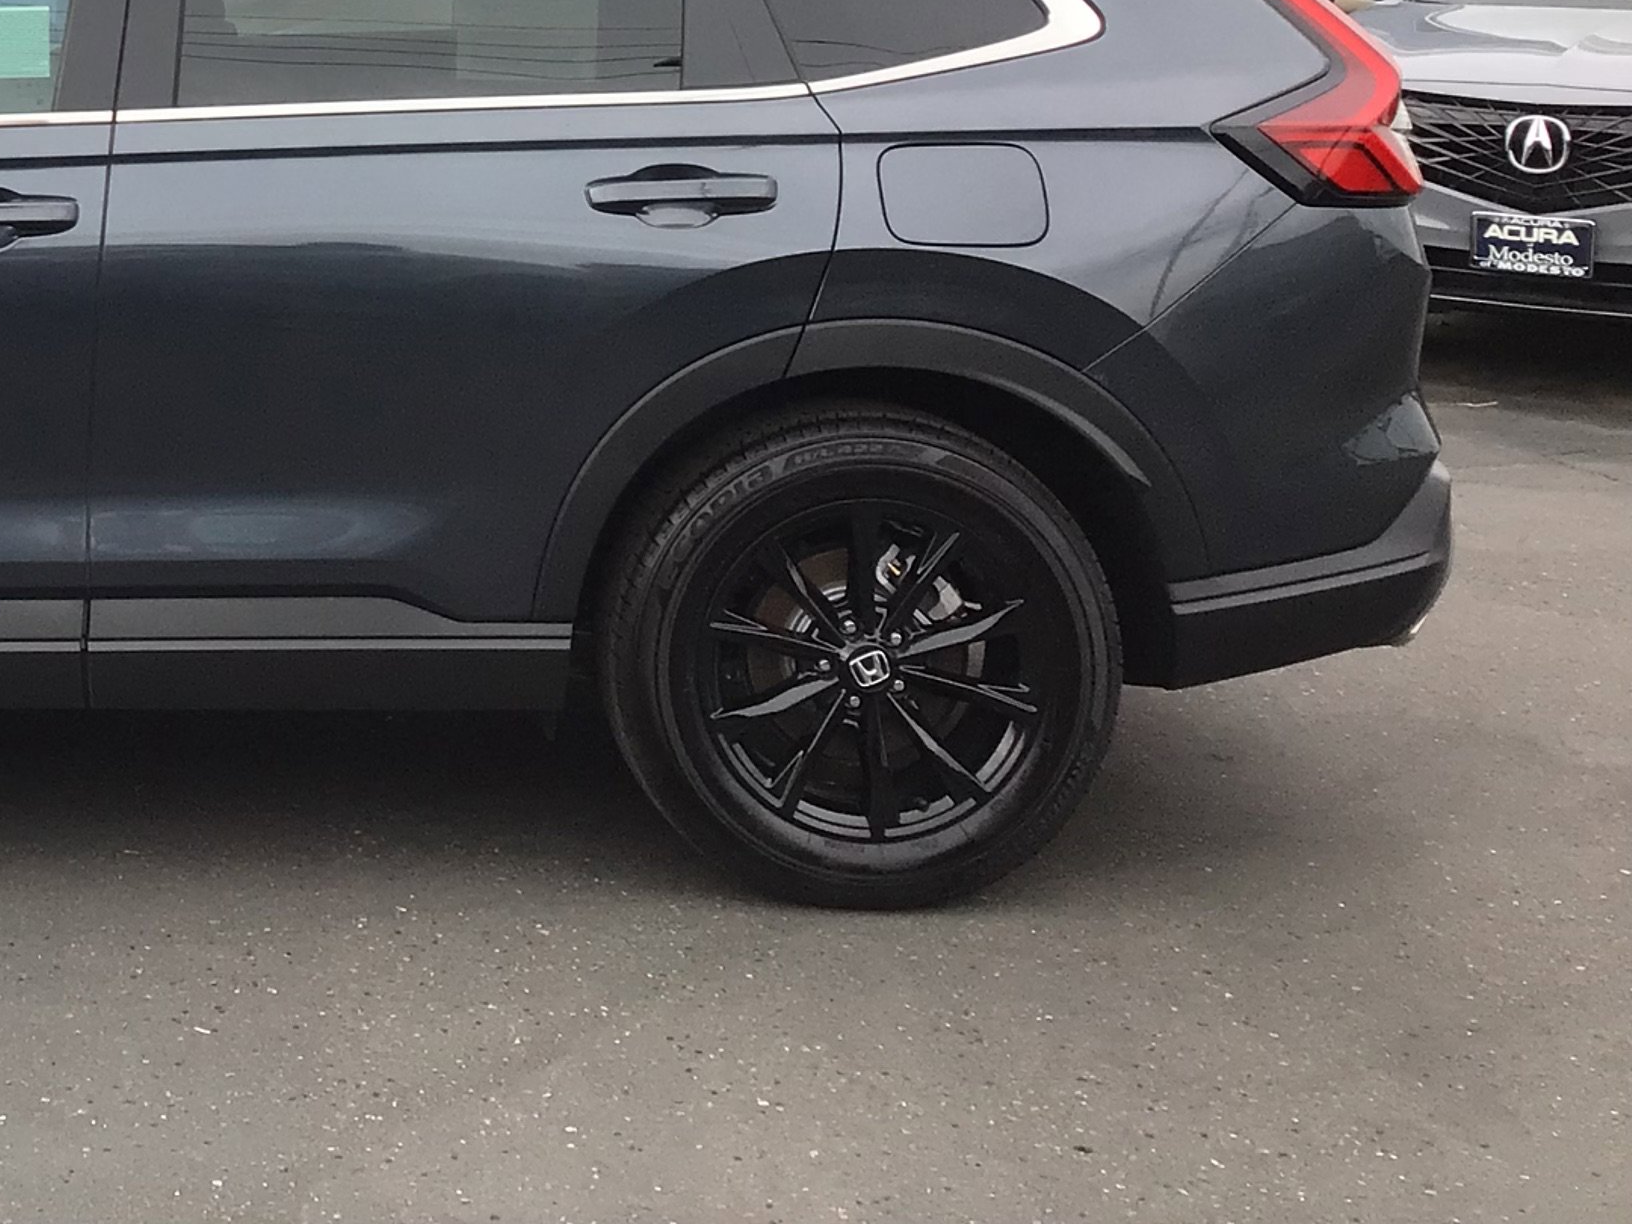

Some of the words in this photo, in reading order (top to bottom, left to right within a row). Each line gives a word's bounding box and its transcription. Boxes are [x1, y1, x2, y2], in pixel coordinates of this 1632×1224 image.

[1482, 223, 1580, 246] ACURA
[1487, 244, 1574, 265] Modesto
[1497, 261, 1585, 277] MODESTO
